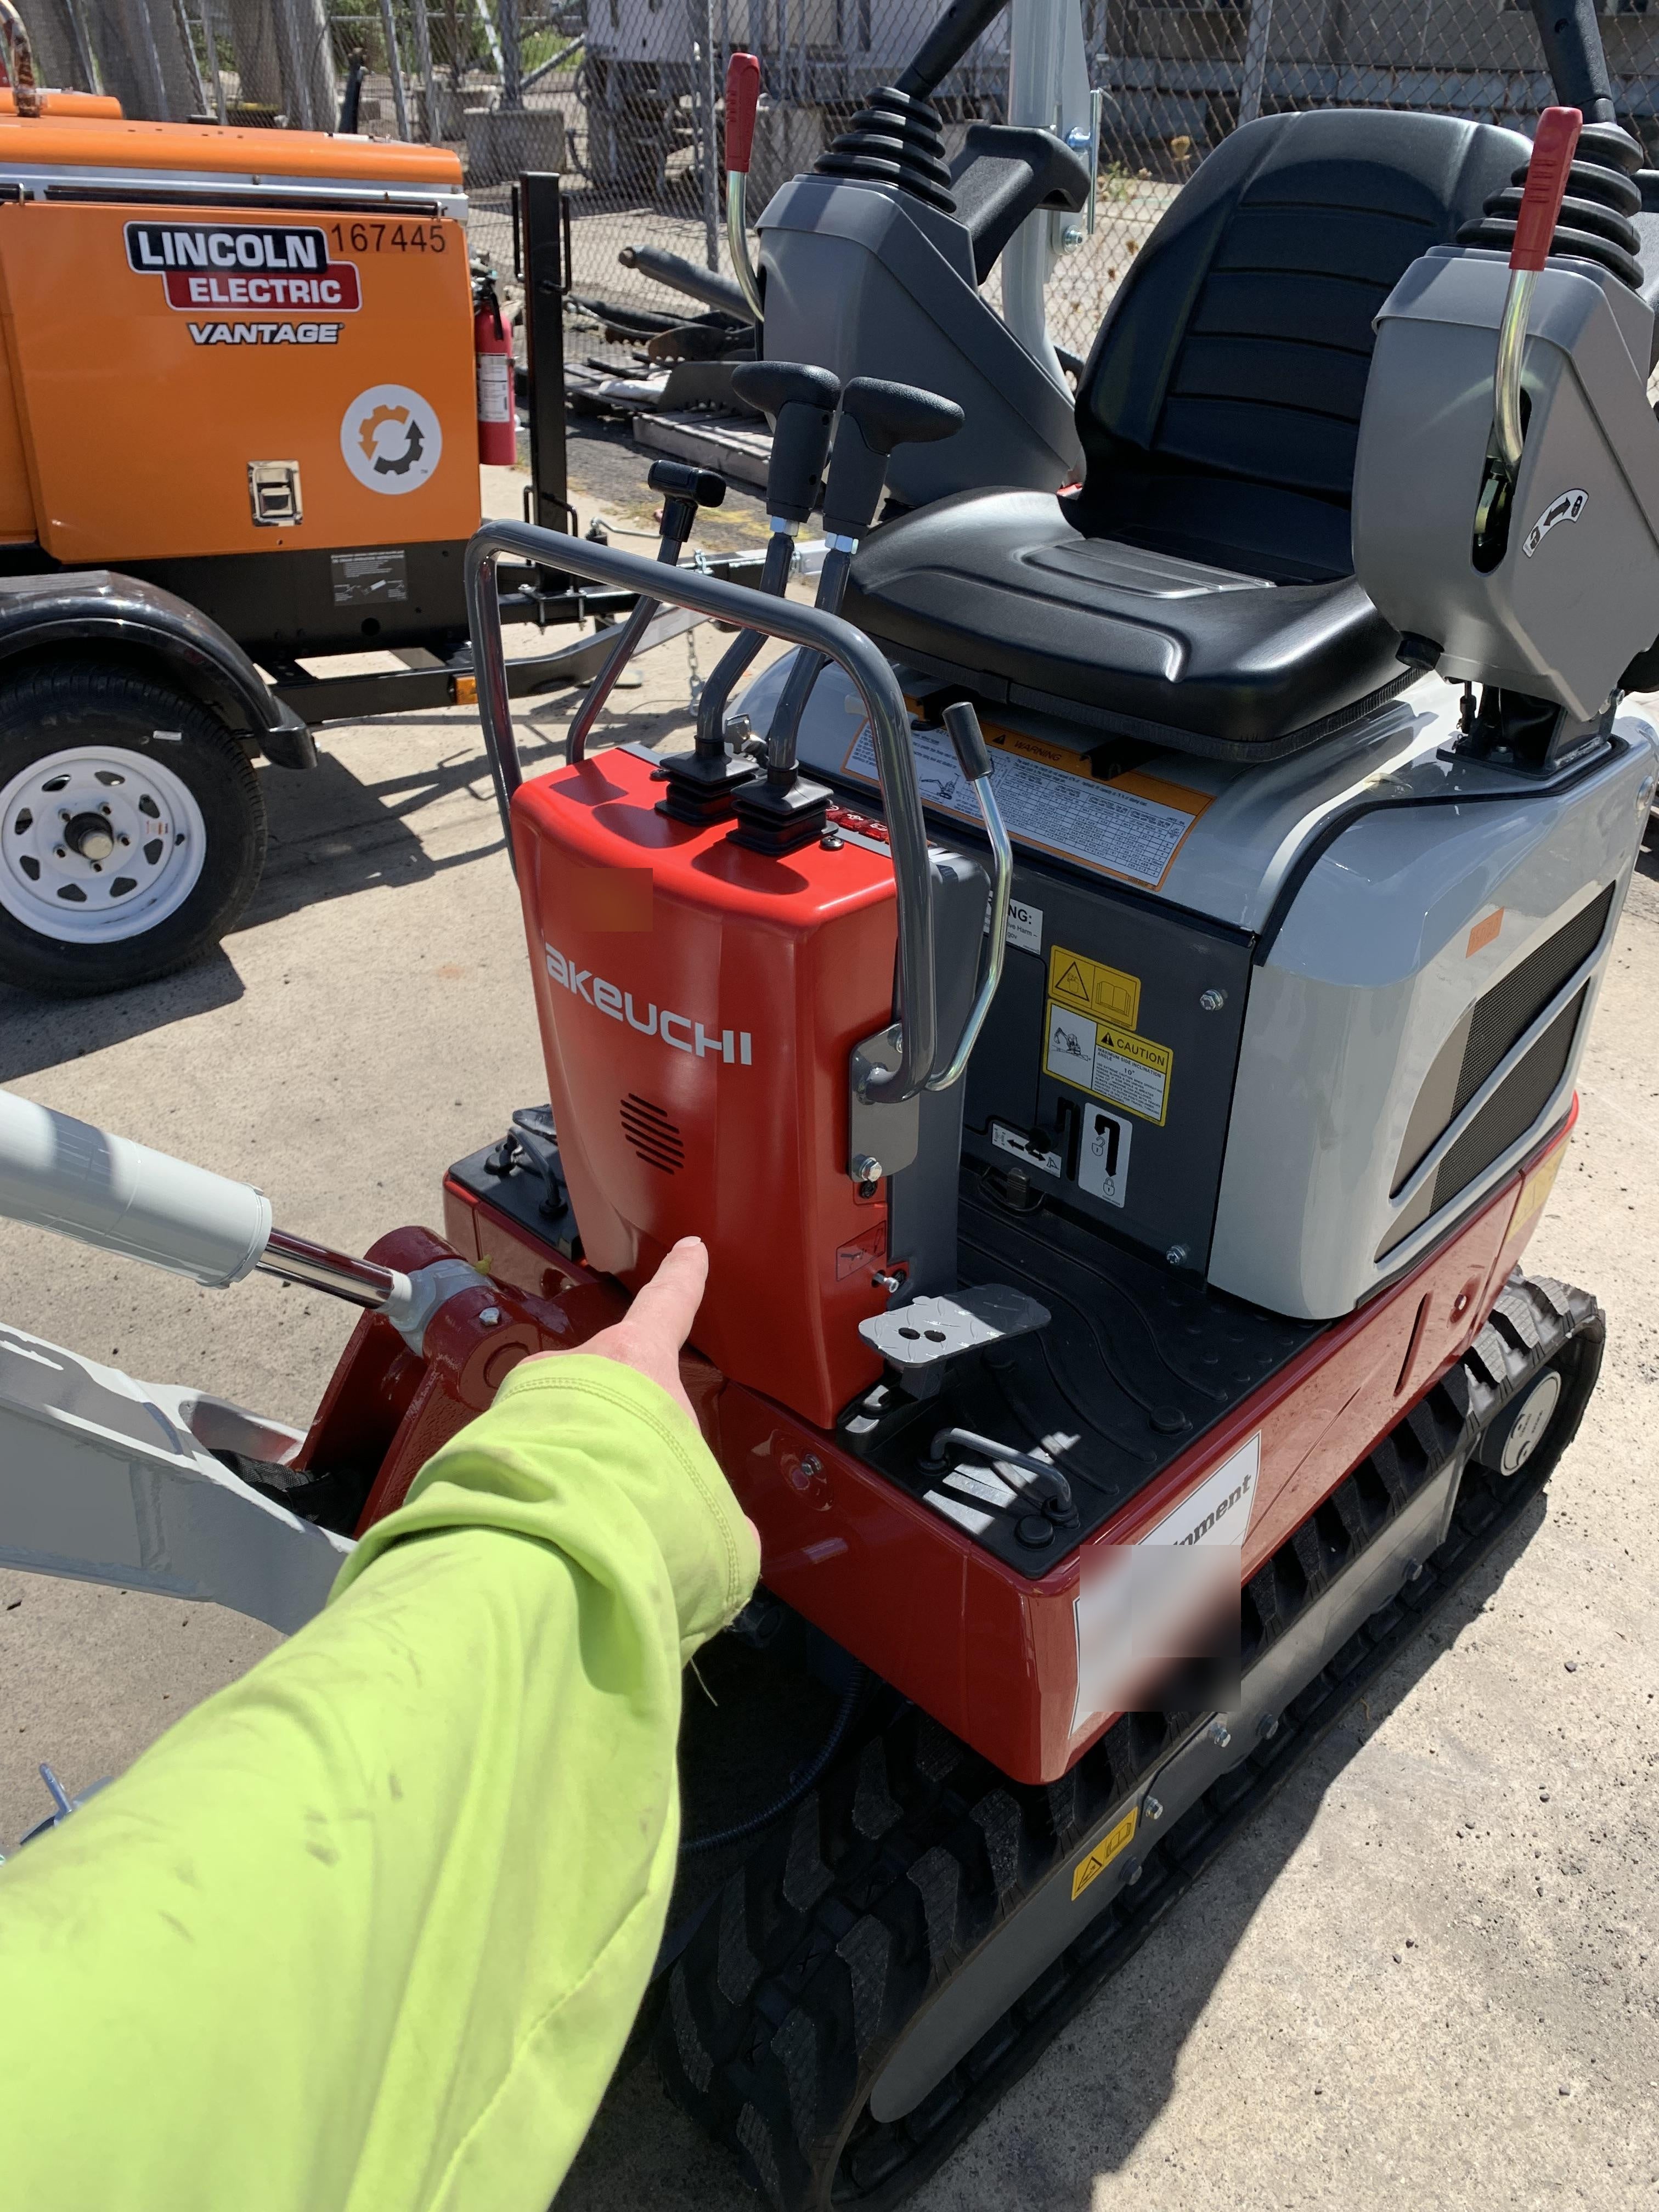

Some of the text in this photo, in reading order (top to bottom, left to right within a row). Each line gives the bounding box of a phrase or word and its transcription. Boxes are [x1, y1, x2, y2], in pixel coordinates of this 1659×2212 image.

[138, 231, 318, 268] LINCOLN
[331, 223, 446, 252] 167445
[188, 277, 342, 303] ELECTRIC
[1014, 741, 1062, 761] WARNING
[1017, 924, 1032, 936] Harm
[1097, 1051, 1112, 1061] ANGLE
[1097, 1047, 1161, 1077] MAXIMUM SIDE INCLINATION
[1116, 1038, 1165, 1066] CAUTION
